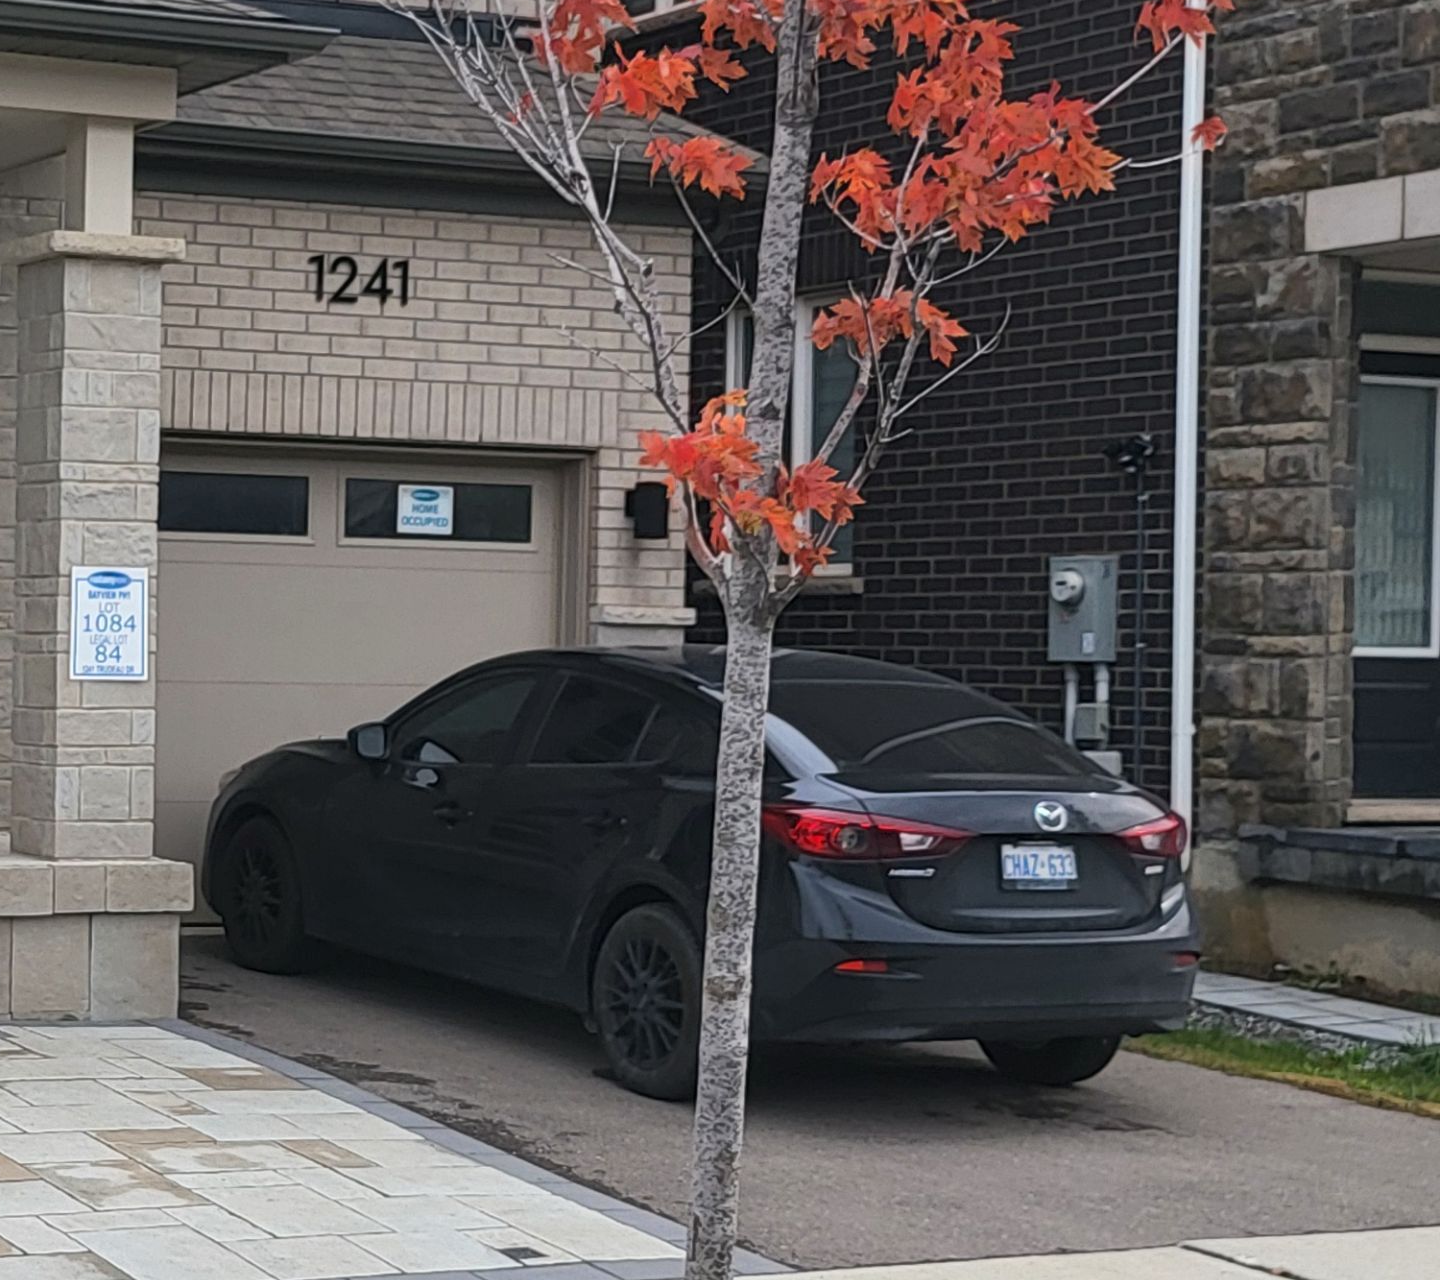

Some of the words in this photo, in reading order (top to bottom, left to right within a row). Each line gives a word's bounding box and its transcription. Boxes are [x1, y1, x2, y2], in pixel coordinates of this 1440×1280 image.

[307, 254, 409, 307] 1241
[411, 504, 439, 513] HOME
[401, 516, 448, 527] OCCUPIED
[99, 602, 120, 613] LOT
[83, 614, 136, 632] 1084
[114, 635, 128, 645] LOT
[95, 645, 121, 663] 84
